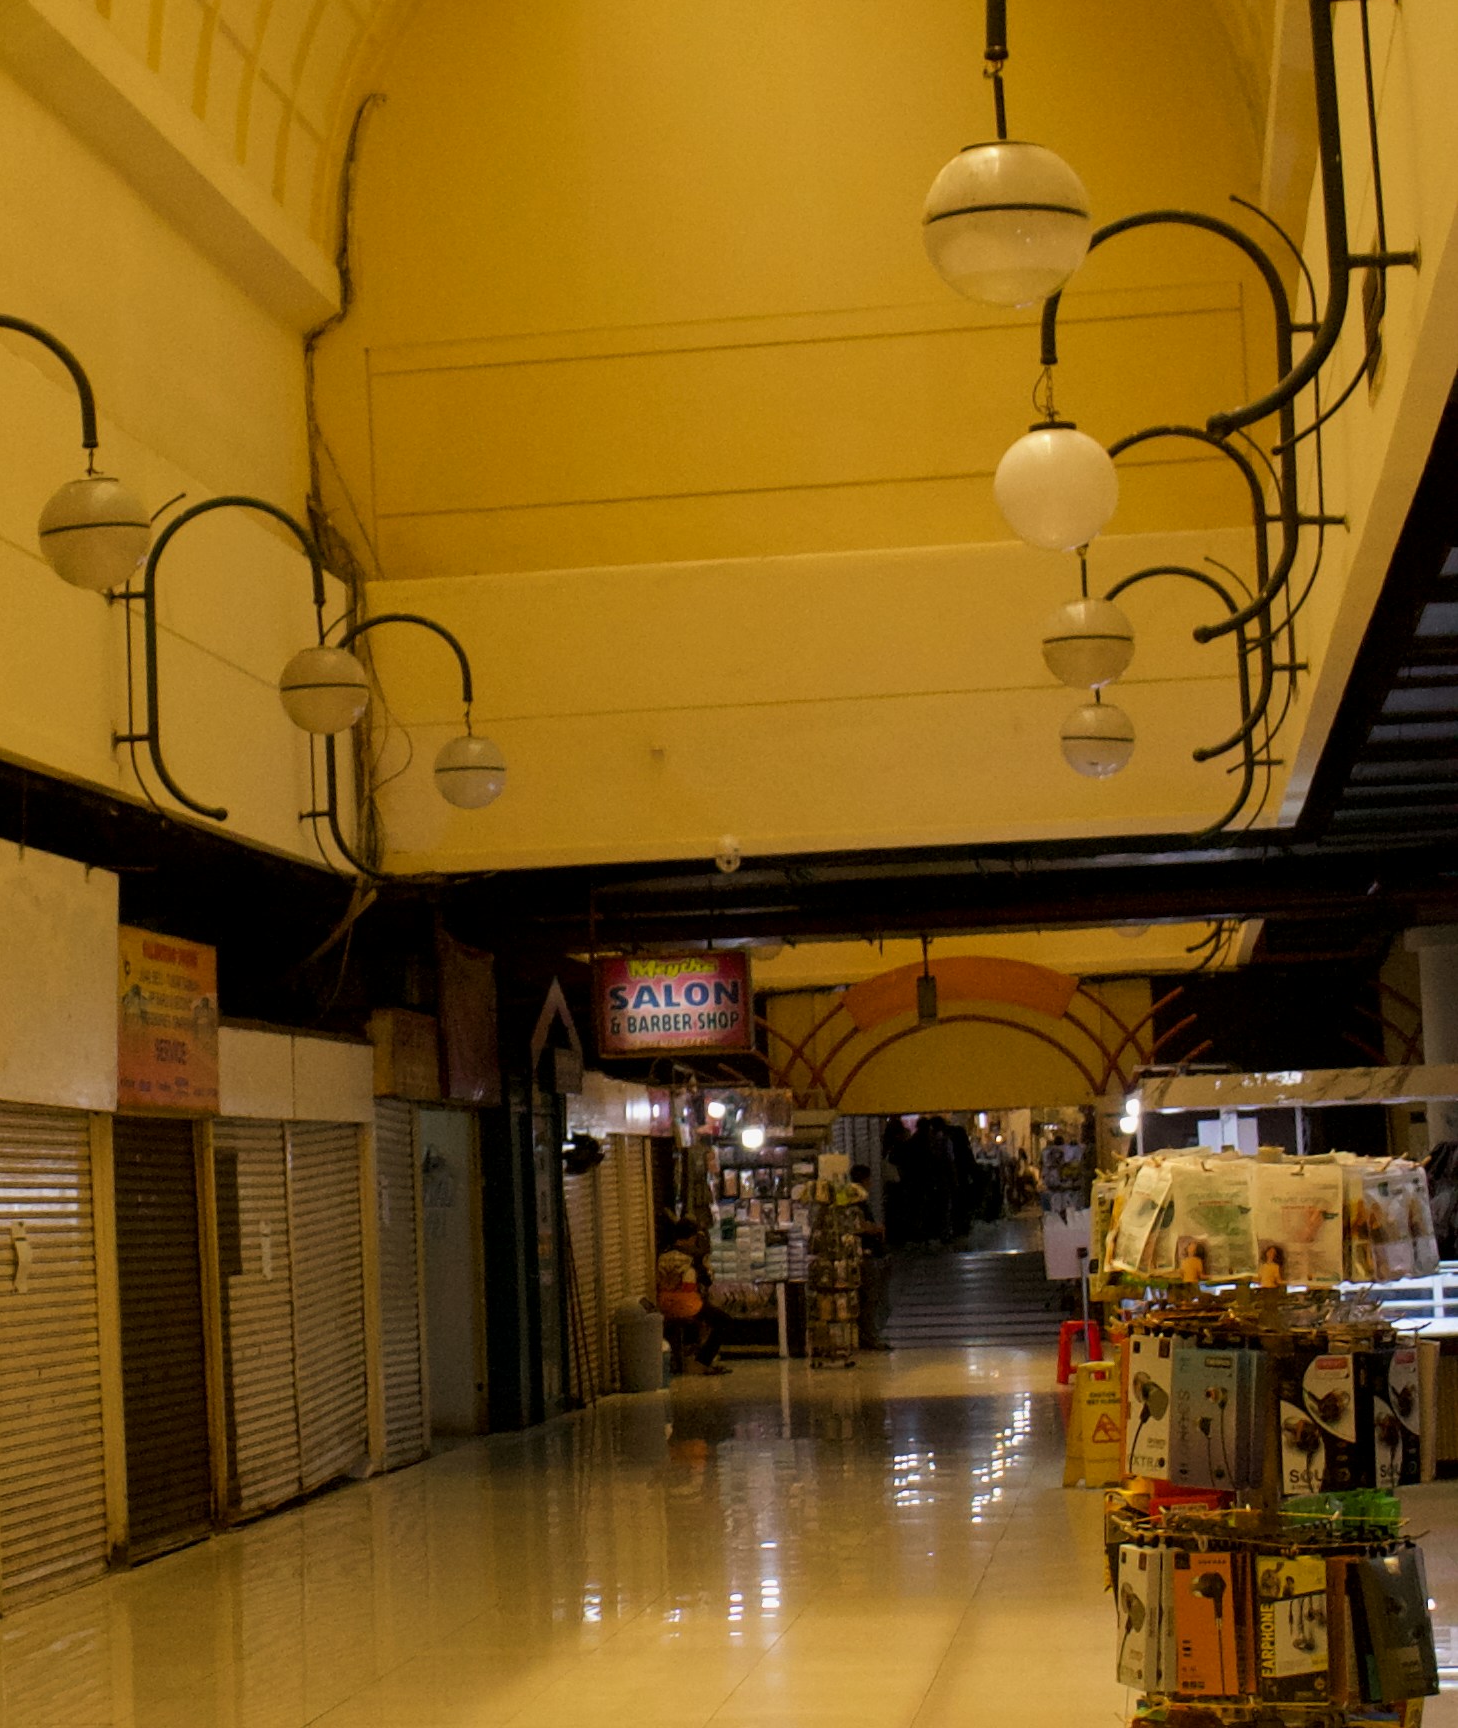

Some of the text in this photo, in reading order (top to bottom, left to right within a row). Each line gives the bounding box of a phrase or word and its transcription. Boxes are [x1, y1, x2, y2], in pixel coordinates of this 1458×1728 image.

[609, 981, 740, 1009] SALON
[611, 1011, 740, 1035] & BARBER SHOP
[1261, 1603, 1276, 1677] EARPHONE
